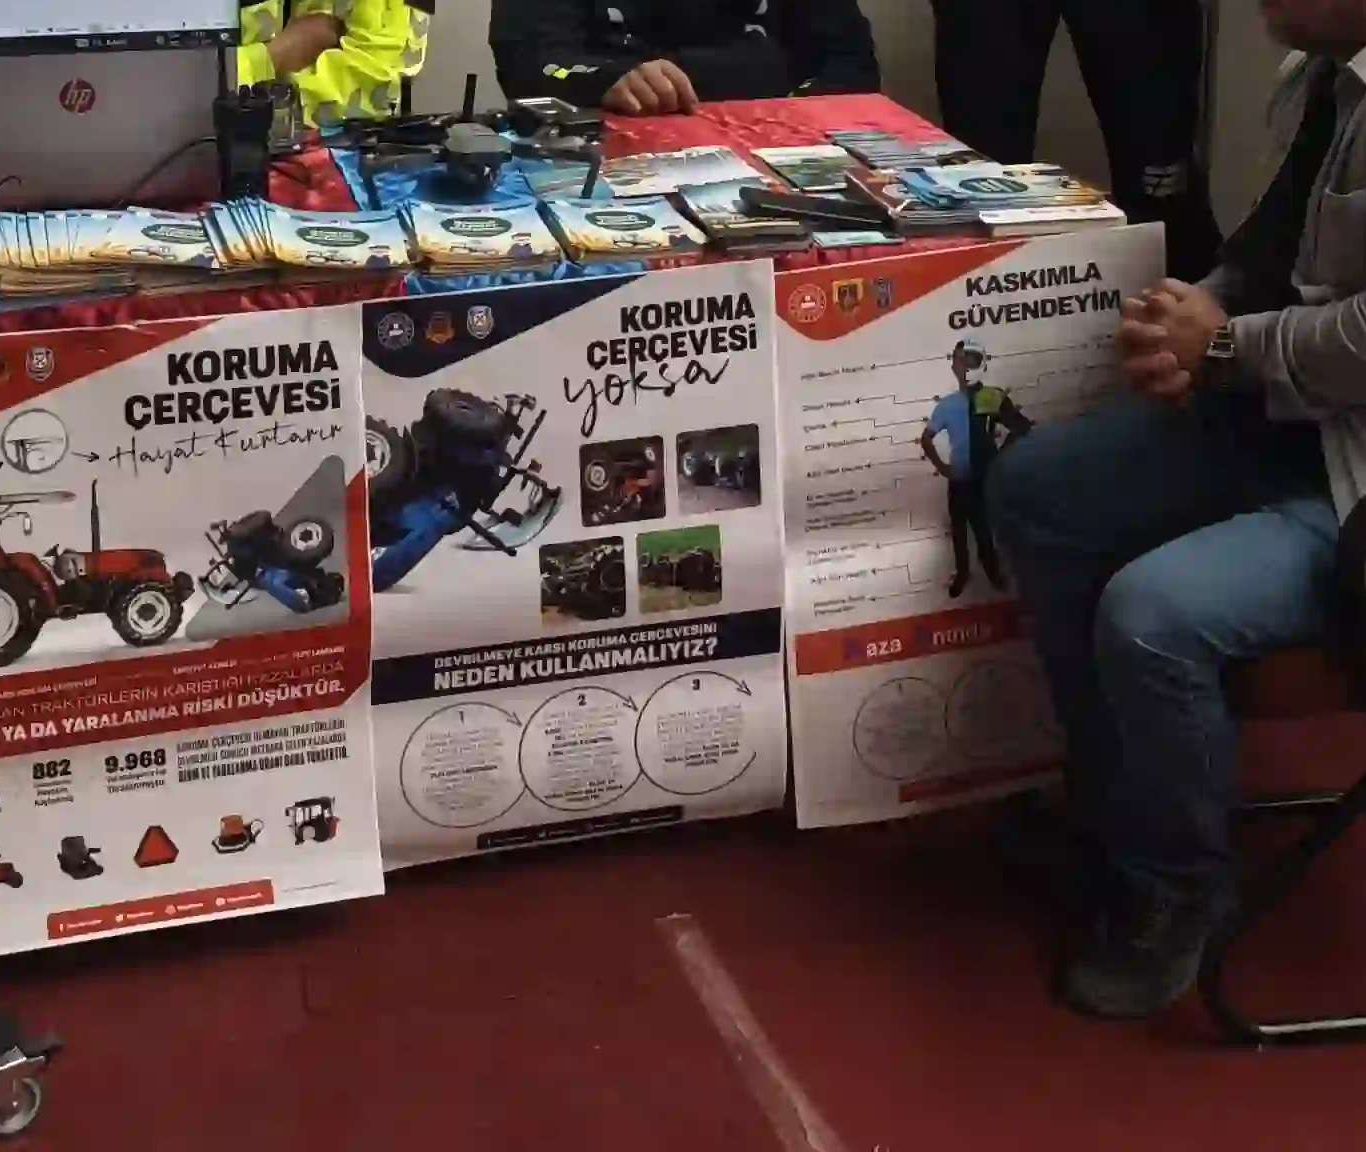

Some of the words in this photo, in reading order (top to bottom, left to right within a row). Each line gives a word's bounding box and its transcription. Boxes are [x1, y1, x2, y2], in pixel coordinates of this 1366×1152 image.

[64, 79, 93, 114] hp
[965, 261, 1103, 297] KASKIMLA
[619, 292, 756, 333] KORUMA
[948, 288, 1121, 331] GÜVENDEYİM
[167, 340, 338, 386] KORUMA
[586, 323, 757, 370] ÇERÇEVESİ
[124, 378, 341, 430] ÇERÇEVESİ
[563, 352, 730, 437] yoksa
[434, 663, 515, 691] NEDEN
[520, 637, 718, 680] KULLANMALIYIZ?
[568, 634, 627, 652] KORUMA
[2, 725, 27, 743] YA
[30, 720, 57, 738] DA
[61, 705, 179, 734] YARALANMA
[182, 694, 234, 716] RİSKİ
[577, 694, 586, 706] 2
[104, 749, 166, 774] 9.968
